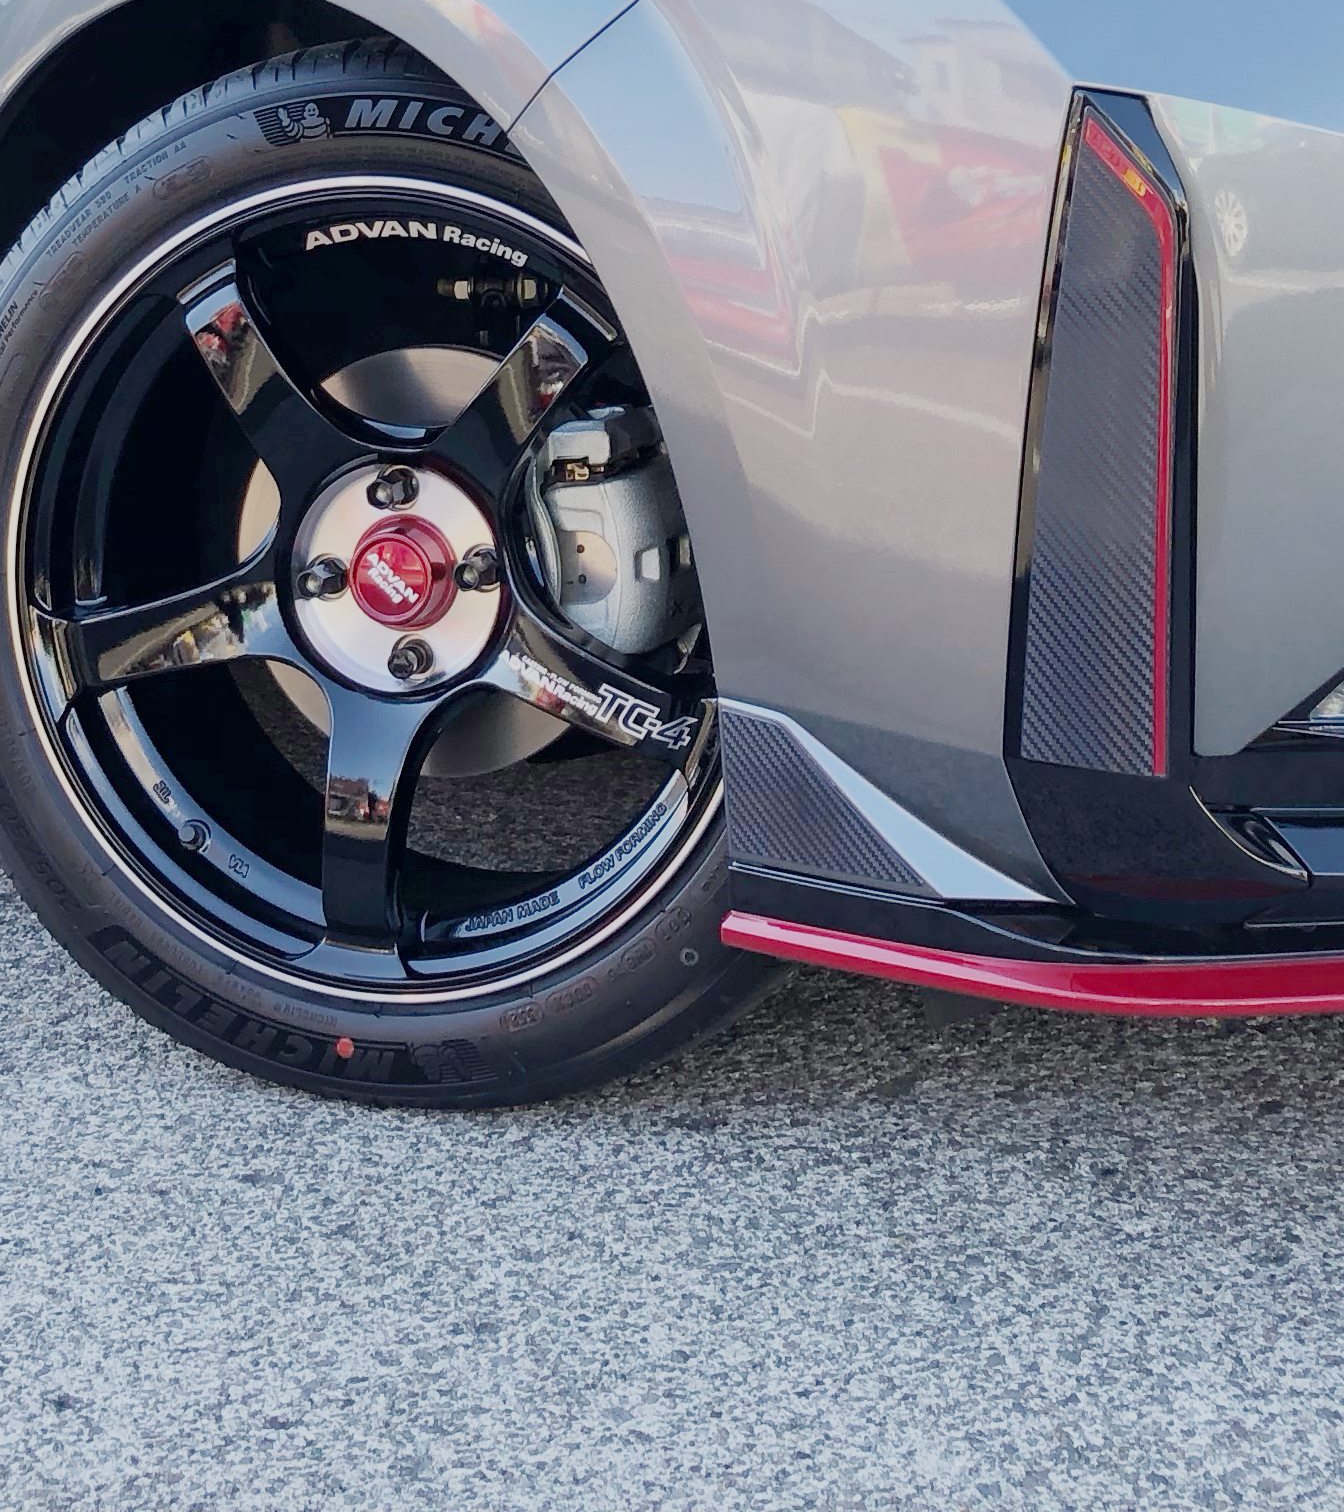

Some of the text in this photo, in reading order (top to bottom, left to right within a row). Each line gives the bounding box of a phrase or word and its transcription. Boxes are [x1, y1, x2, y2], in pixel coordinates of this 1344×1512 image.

[344, 96, 519, 156] MICH
[304, 220, 529, 269] ADVAN Racing
[366, 552, 420, 604] ADVAN
[594, 682, 699, 751] TC-4
[465, 802, 668, 933] JAPAN MADE FLOW FORMING
